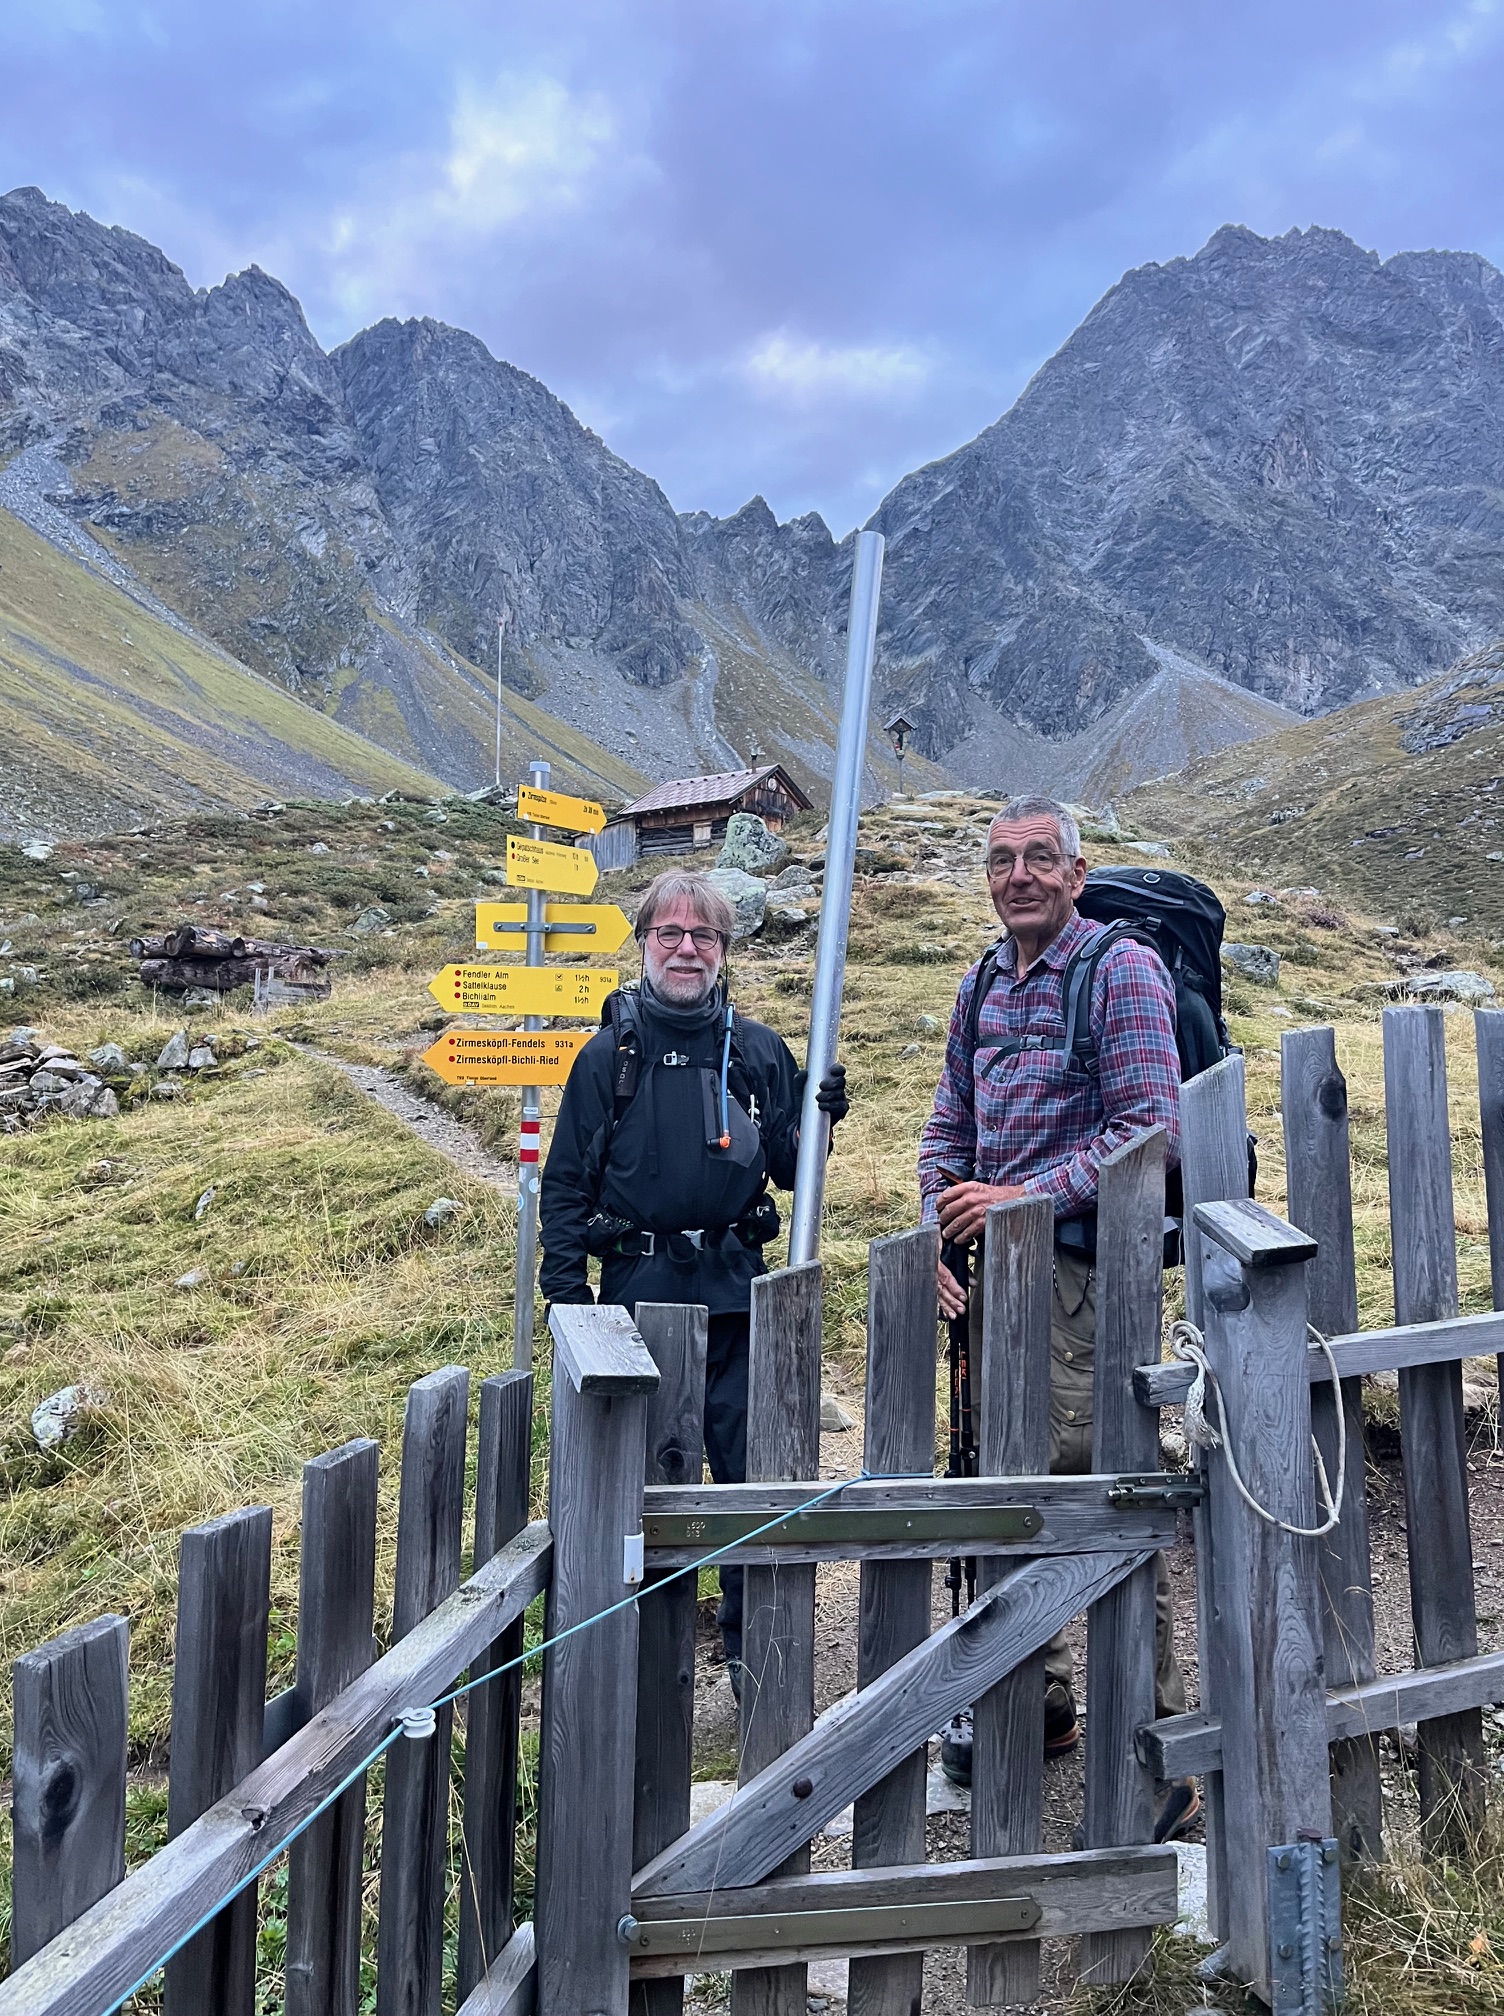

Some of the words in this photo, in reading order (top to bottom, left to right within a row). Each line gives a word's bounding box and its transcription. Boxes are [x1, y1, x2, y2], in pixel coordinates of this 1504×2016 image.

[462, 969, 491, 979] Fendler
[495, 971, 509, 979] Alm
[462, 980, 507, 991] Sattelklause
[462, 992, 497, 1001] Bichlialm
[456, 1037, 546, 1050] Zirmesköpfl-Fendels
[554, 1039, 574, 1049] 931a
[456, 1054, 559, 1066] Zirmesköpfl-Bichli-Ried
